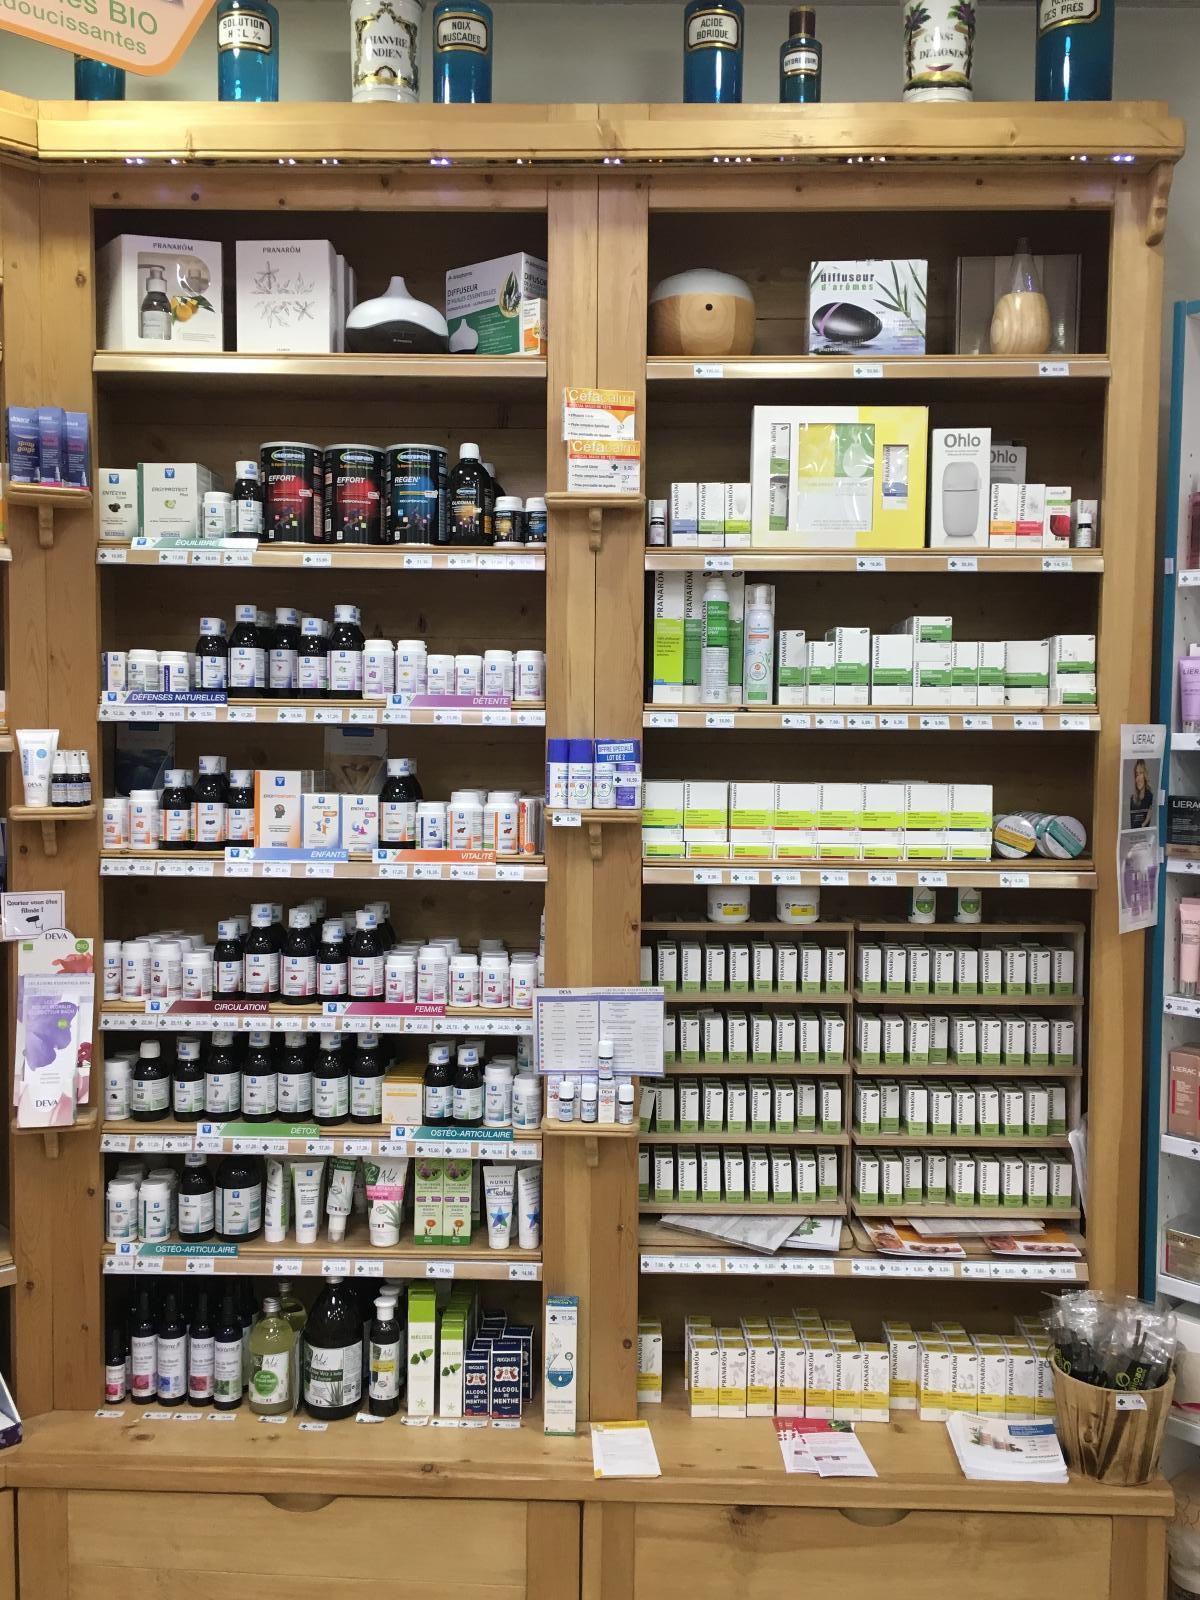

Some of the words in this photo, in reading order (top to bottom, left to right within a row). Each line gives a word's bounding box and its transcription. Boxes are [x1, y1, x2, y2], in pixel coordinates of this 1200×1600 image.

[109, 0, 158, 35] BIO
[0, 0, 146, 55] doucissantes
[223, 18, 264, 30] SOLUTION
[452, 21, 471, 30] NOIX
[701, 18, 723, 28] ACIDE
[696, 28, 728, 40] BORIQUE
[370, 48, 402, 58] NDIEN
[153, 242, 194, 251] PRANARÔM
[820, 272, 875, 282] diffuseur
[448, 284, 478, 298] DIFFUSEUR
[944, 434, 981, 448] Ohlo
[174, 694, 226, 702] NATURELLES
[472, 697, 509, 705] DÉTENTE
[1132, 734, 1156, 745] LIERAC
[310, 850, 348, 858] ENFANTS
[460, 852, 494, 860] VITALITÉ
[214, 1003, 266, 1012] CIRCULATION
[414, 1005, 444, 1014] FEMME
[36, 1100, 59, 1108] DEVA
[430, 1128, 512, 1138] OSTÉO-ARTICULAIRE
[156, 1244, 236, 1254] OSTÉO-ARTICULAIRE
